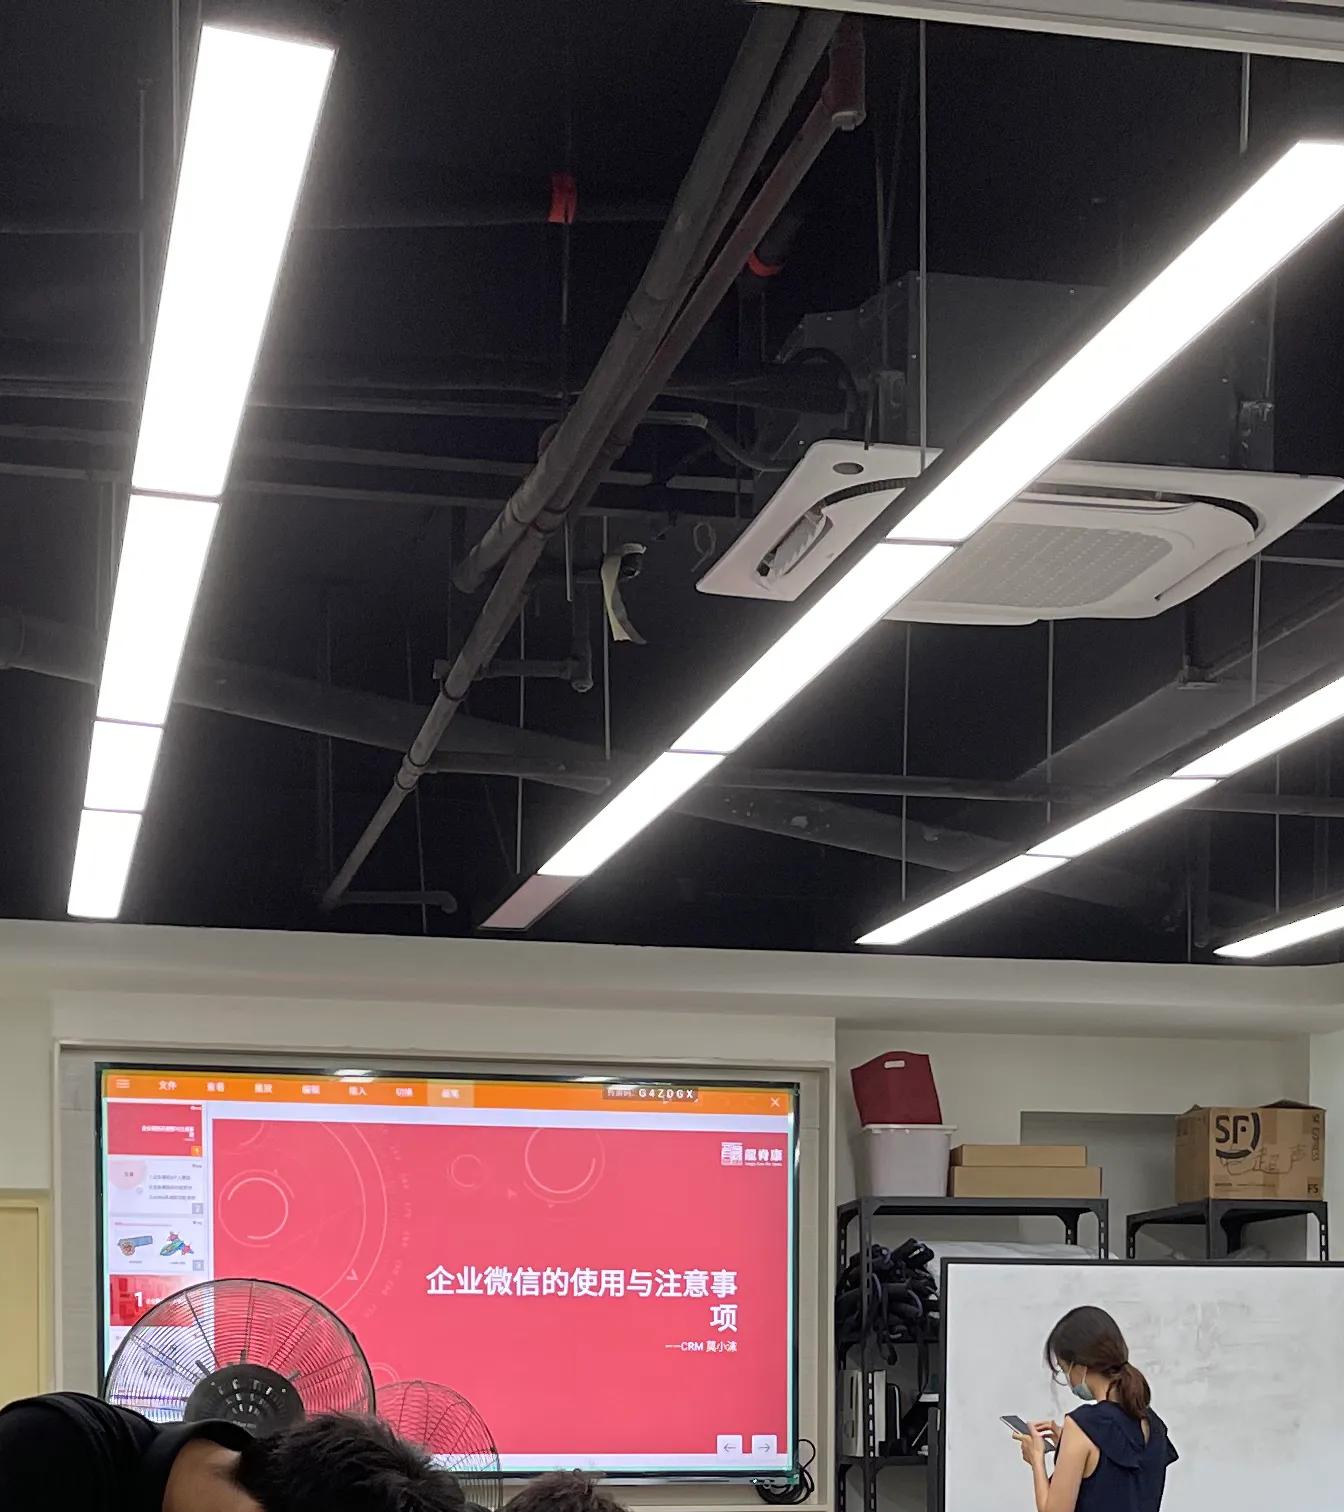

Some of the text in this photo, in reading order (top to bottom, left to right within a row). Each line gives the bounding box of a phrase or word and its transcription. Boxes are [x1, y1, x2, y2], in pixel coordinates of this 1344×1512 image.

[425, 1265, 738, 1298] 企业微信的使用与注意事
[709, 1303, 738, 1332] 项
